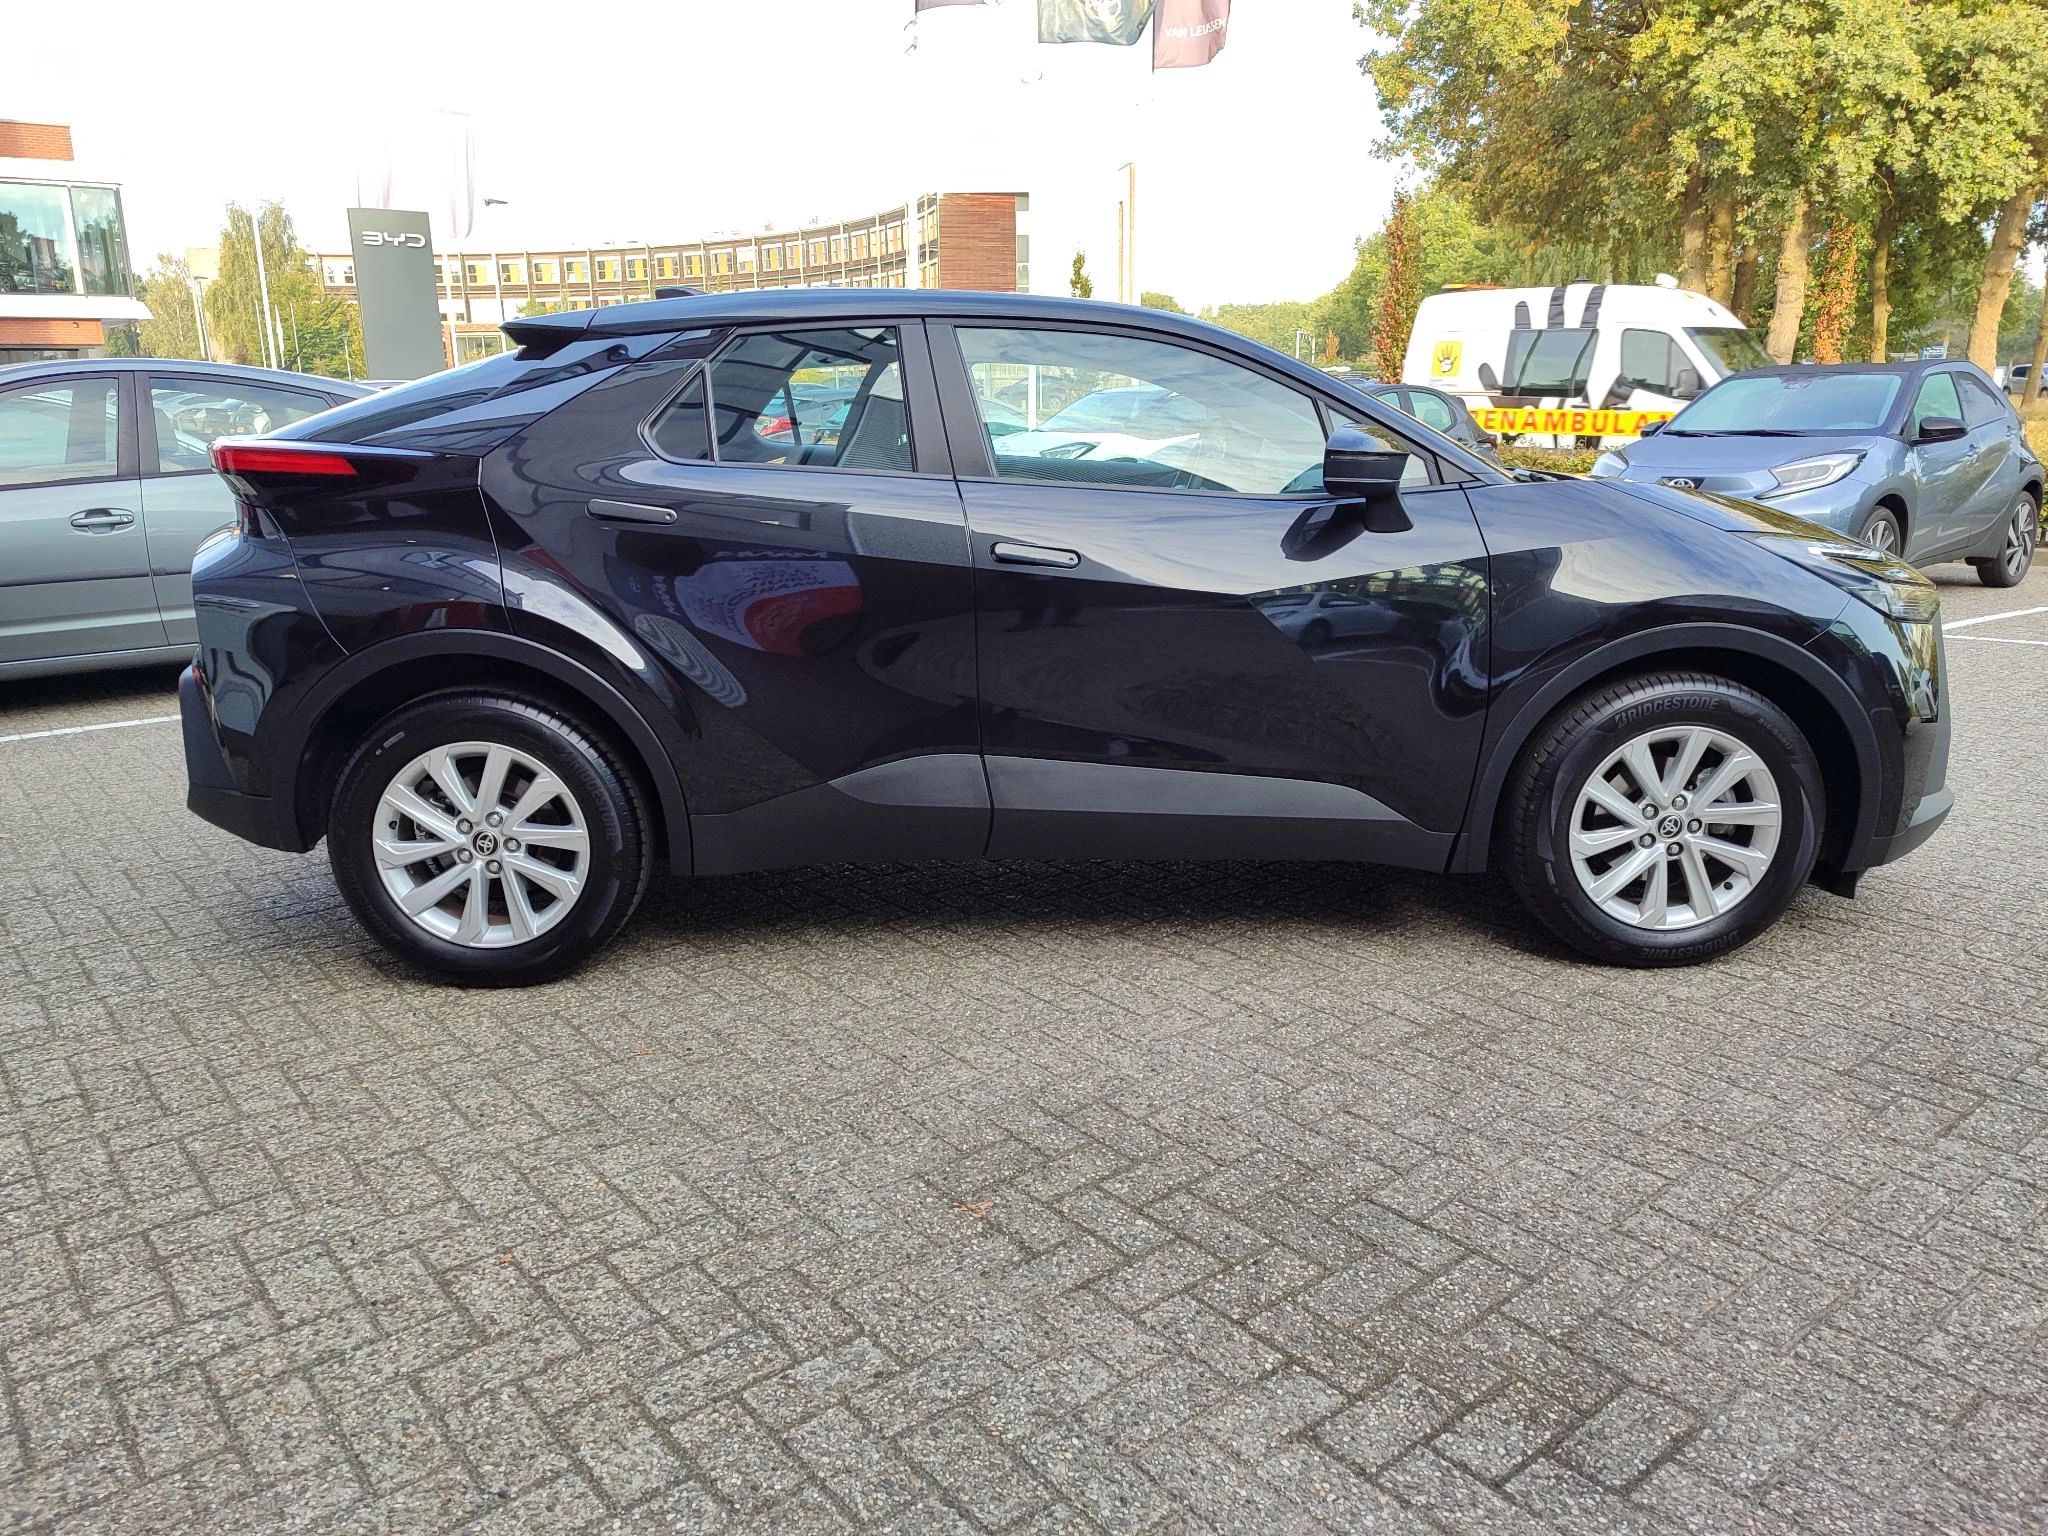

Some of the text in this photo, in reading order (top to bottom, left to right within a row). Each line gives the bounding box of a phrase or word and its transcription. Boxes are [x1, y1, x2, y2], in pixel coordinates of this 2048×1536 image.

[1164, 26, 1188, 38] VAN
[361, 231, 426, 248] BYD
[1468, 410, 1669, 434] ENAMBULA
[1614, 696, 1719, 728] BRIDGESTONE
